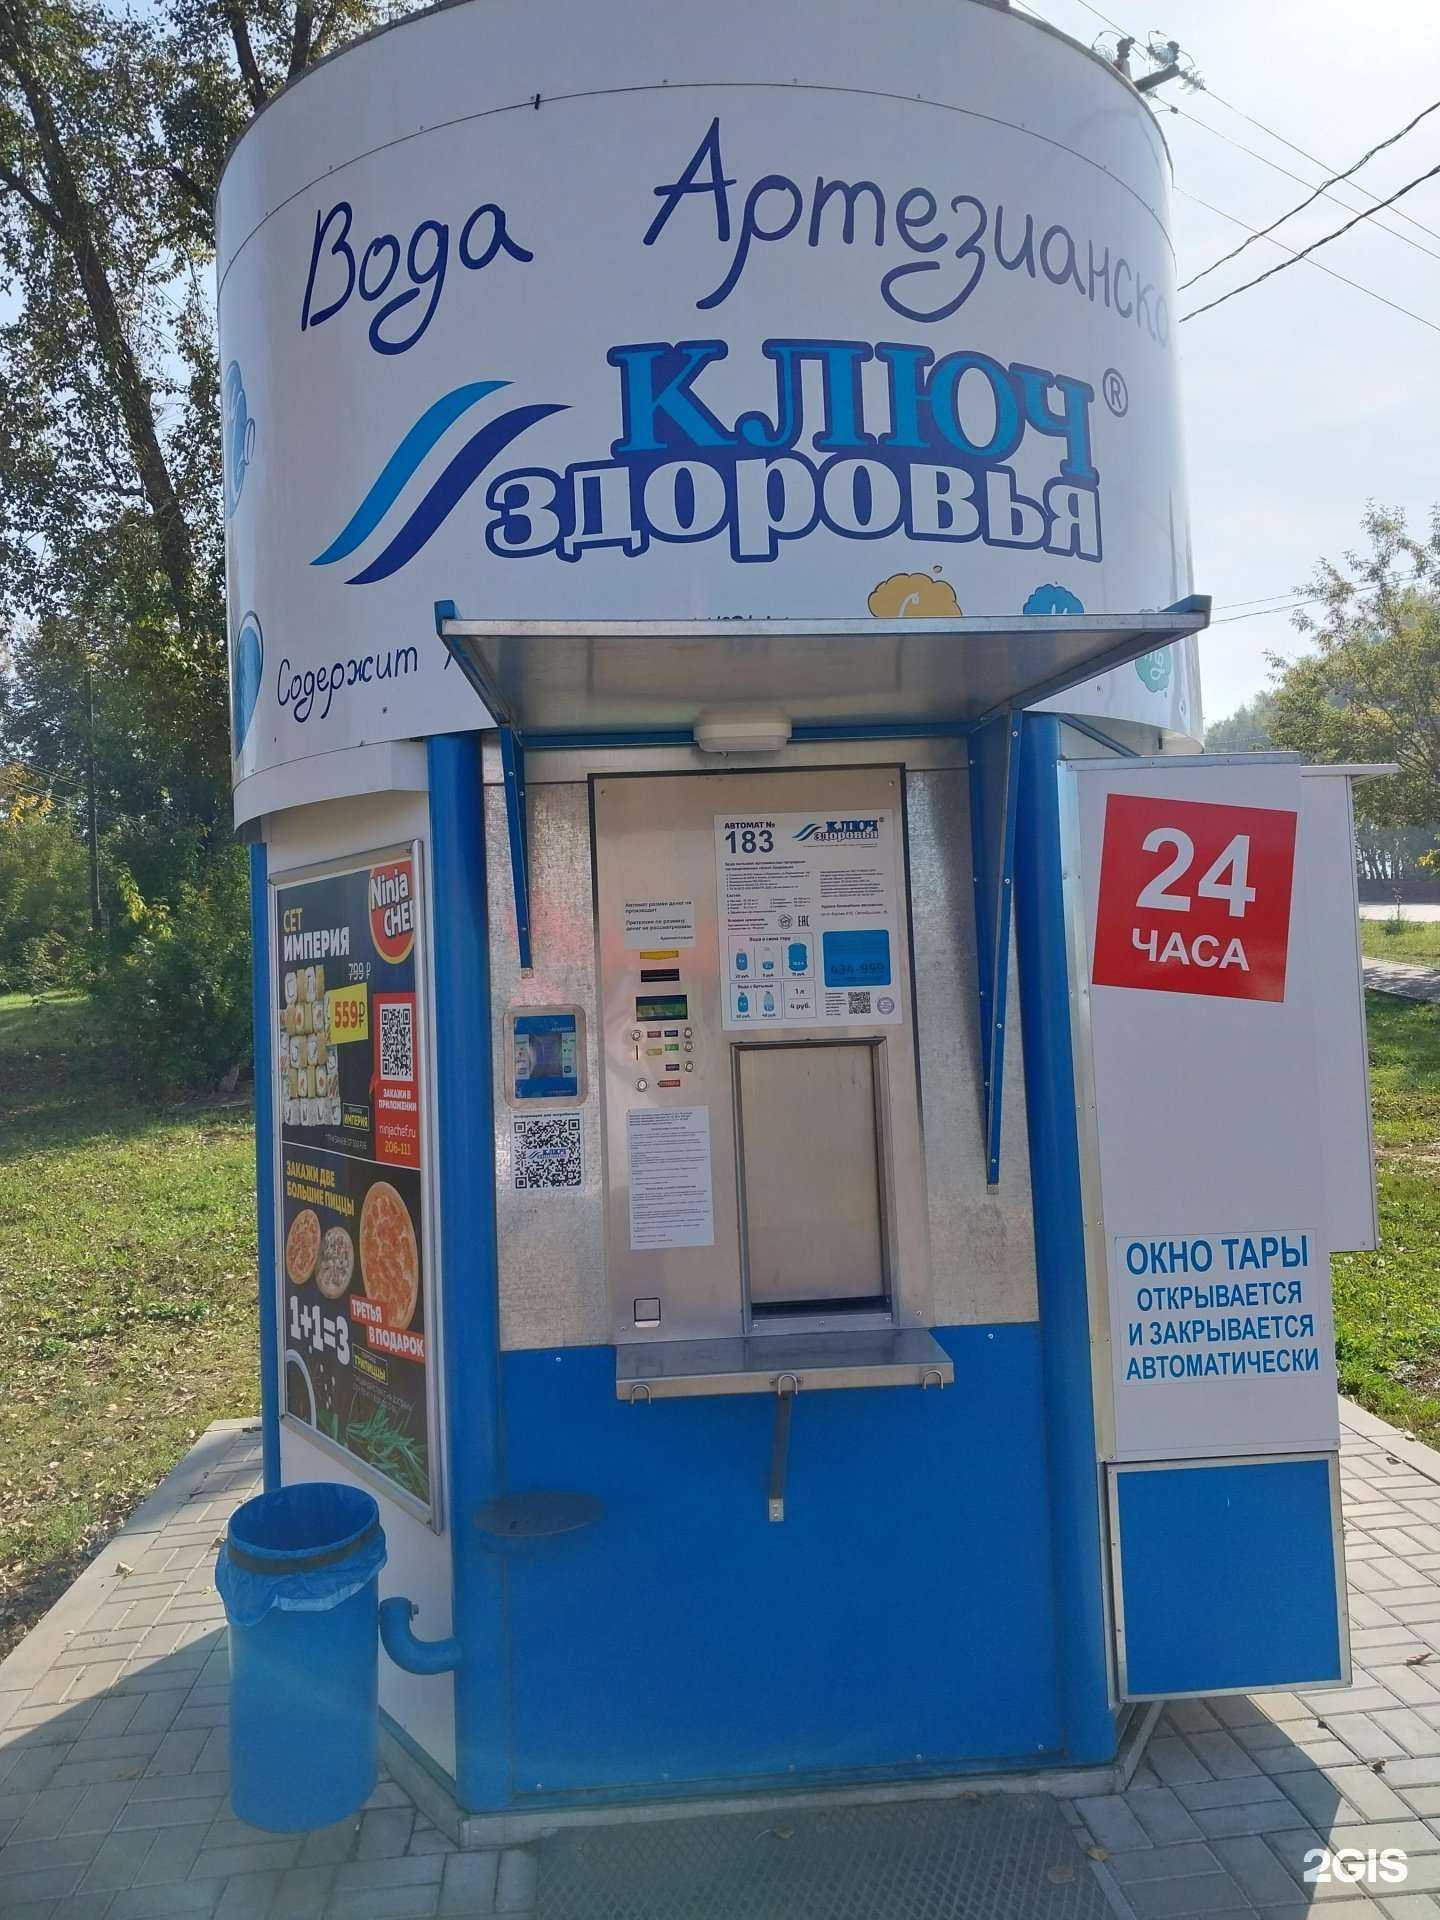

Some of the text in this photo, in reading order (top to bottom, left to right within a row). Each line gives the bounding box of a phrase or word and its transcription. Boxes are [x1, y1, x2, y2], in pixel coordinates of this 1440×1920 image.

[301, 201, 534, 355] Вода
[606, 339, 1100, 485] КЛЮЧ
[485, 455, 1102, 563] здоровья
[277, 646, 417, 723] Содержит
[724, 821, 764, 830] АВТОМАТ
[826, 819, 879, 833] КЛЮЧ
[725, 829, 774, 854] 183
[1135, 826, 1256, 918] 24
[370, 868, 409, 912] Ninja
[283, 907, 302, 933] СЕТ
[284, 926, 350, 961] ИМПЕРИЯ
[1131, 927, 1251, 971] ЧАСА
[347, 963, 364, 982] 799
[378, 1099, 417, 1112] ПРИЛОЖЕНИИ
[383, 1088, 406, 1099] ЗАКАЖИ
[379, 1123, 416, 1138] ninjachef.ru
[384, 1141, 411, 1156] 206-111
[286, 1160, 336, 1188] ЗАКАЖИ ДВЕ
[286, 1180, 355, 1216] БОЛЬШИЕ ПИЦЦЫ
[1126, 1235, 1308, 1275] ОКНО ТАРЫ
[351, 1299, 383, 1323] ТРЕТЬЯ
[1136, 1280, 1302, 1311] ОТКРЫВАЕТСЯ
[289, 1295, 351, 1366] 1+1=3
[375, 1328, 425, 1357] ПОДАРОК
[1128, 1314, 1314, 1346] И ЗАКРЫВАЕТСЯ
[1126, 1347, 1319, 1380] АВТОМАТИЧЕСКИ
